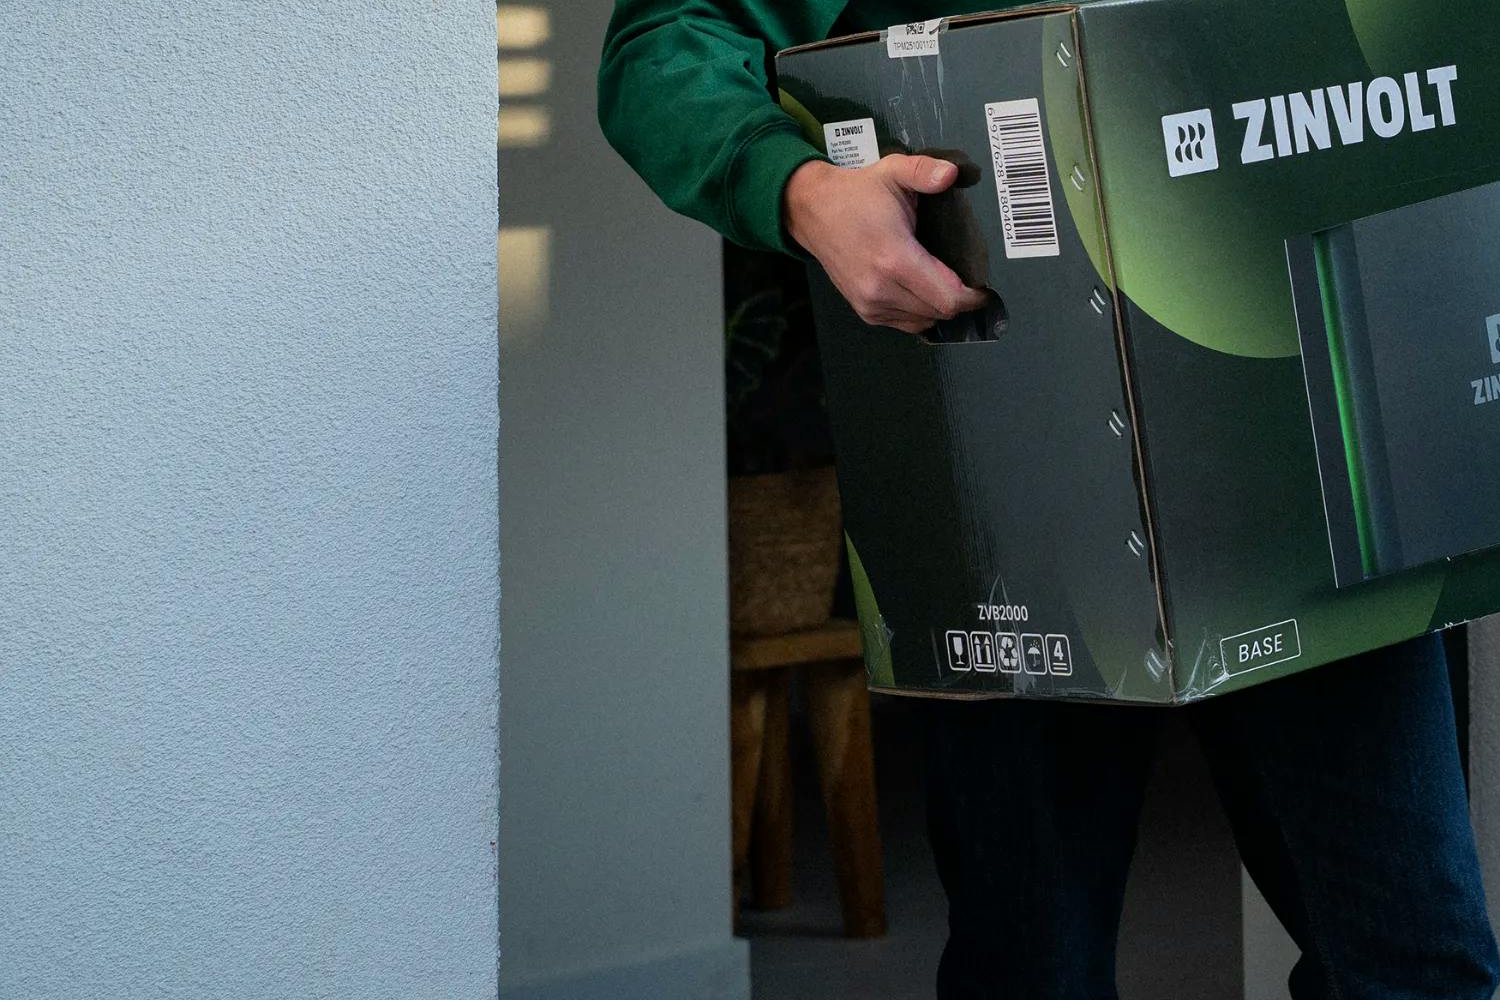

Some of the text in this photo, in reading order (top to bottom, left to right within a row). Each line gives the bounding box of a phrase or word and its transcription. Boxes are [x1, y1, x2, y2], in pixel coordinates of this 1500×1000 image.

[1232, 64, 1458, 165] ZINVOLT
[841, 125, 864, 136] ZINVOLT
[987, 107, 1014, 240] 6 977628 180404
[977, 604, 1029, 621] ZVB2000
[1238, 633, 1283, 663] BASE
